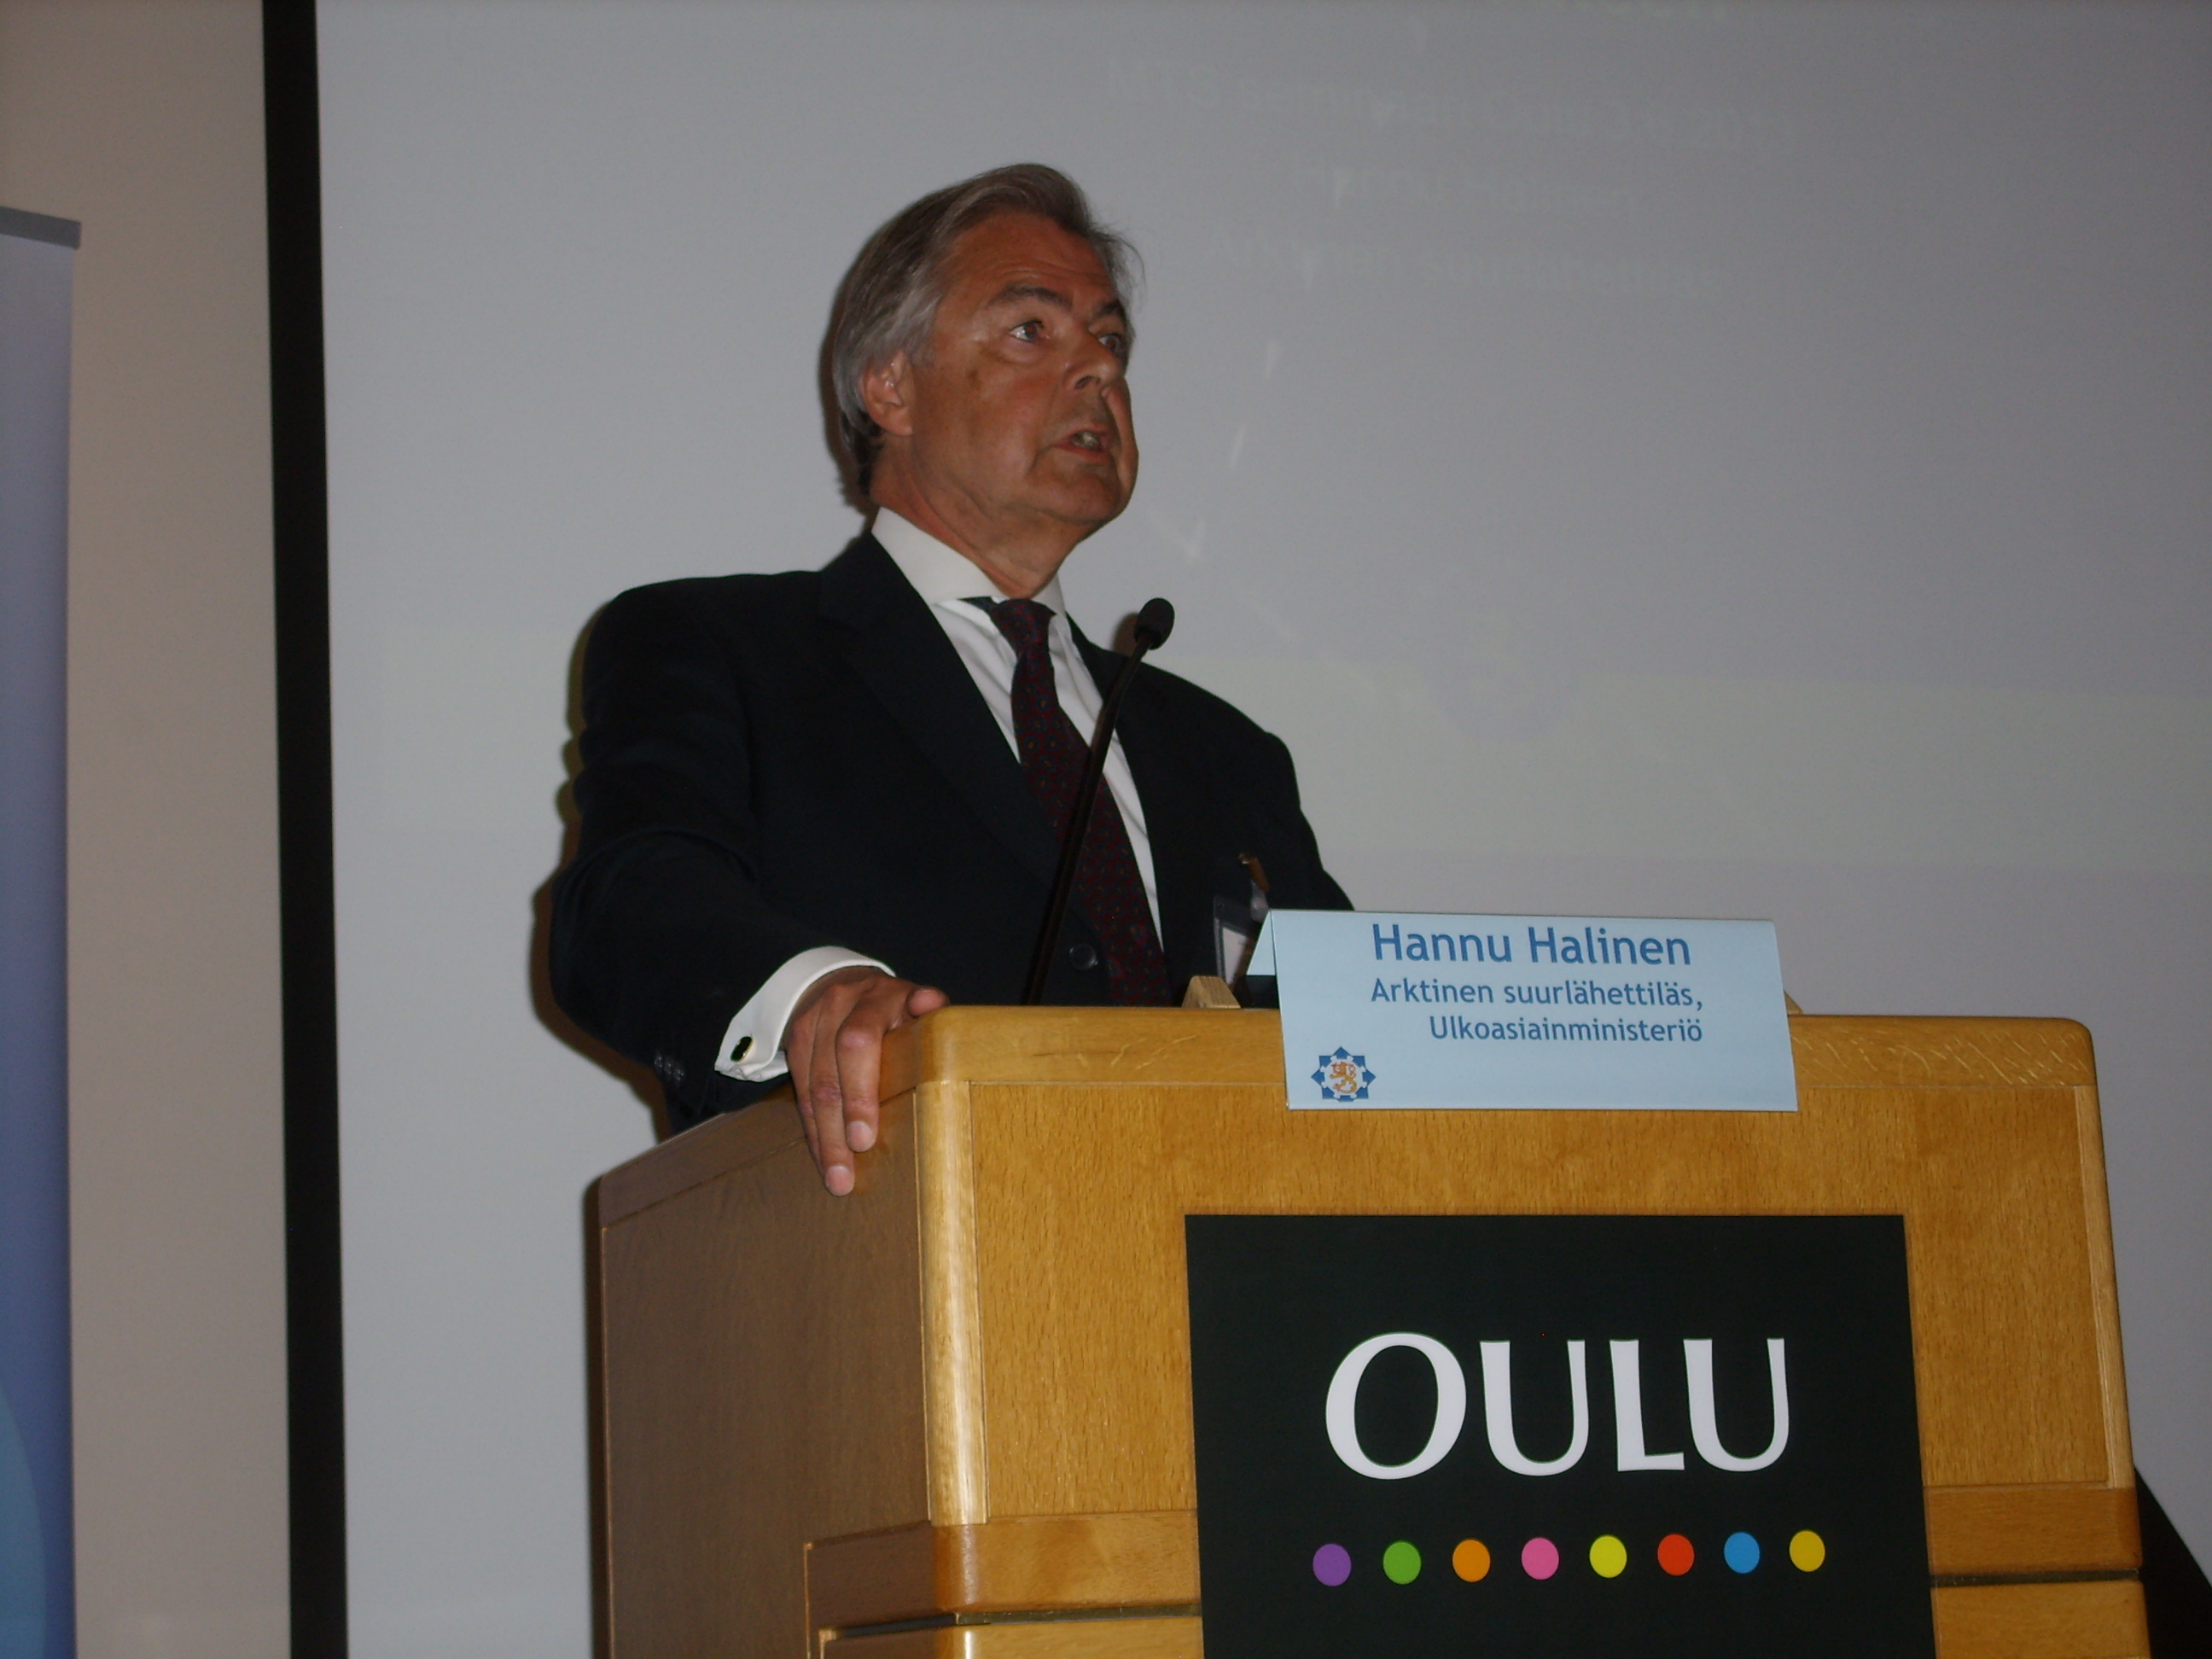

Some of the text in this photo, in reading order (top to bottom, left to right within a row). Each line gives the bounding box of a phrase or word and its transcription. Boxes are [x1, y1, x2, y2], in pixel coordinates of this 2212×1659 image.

[1372, 923, 1691, 965] Hannu Halinen
[1371, 977, 1703, 1011] Arktinen suurlähettiläs,
[1429, 1015, 1703, 1042] Ulkoasiainministeriö
[1325, 1331, 1790, 1480] OULU
